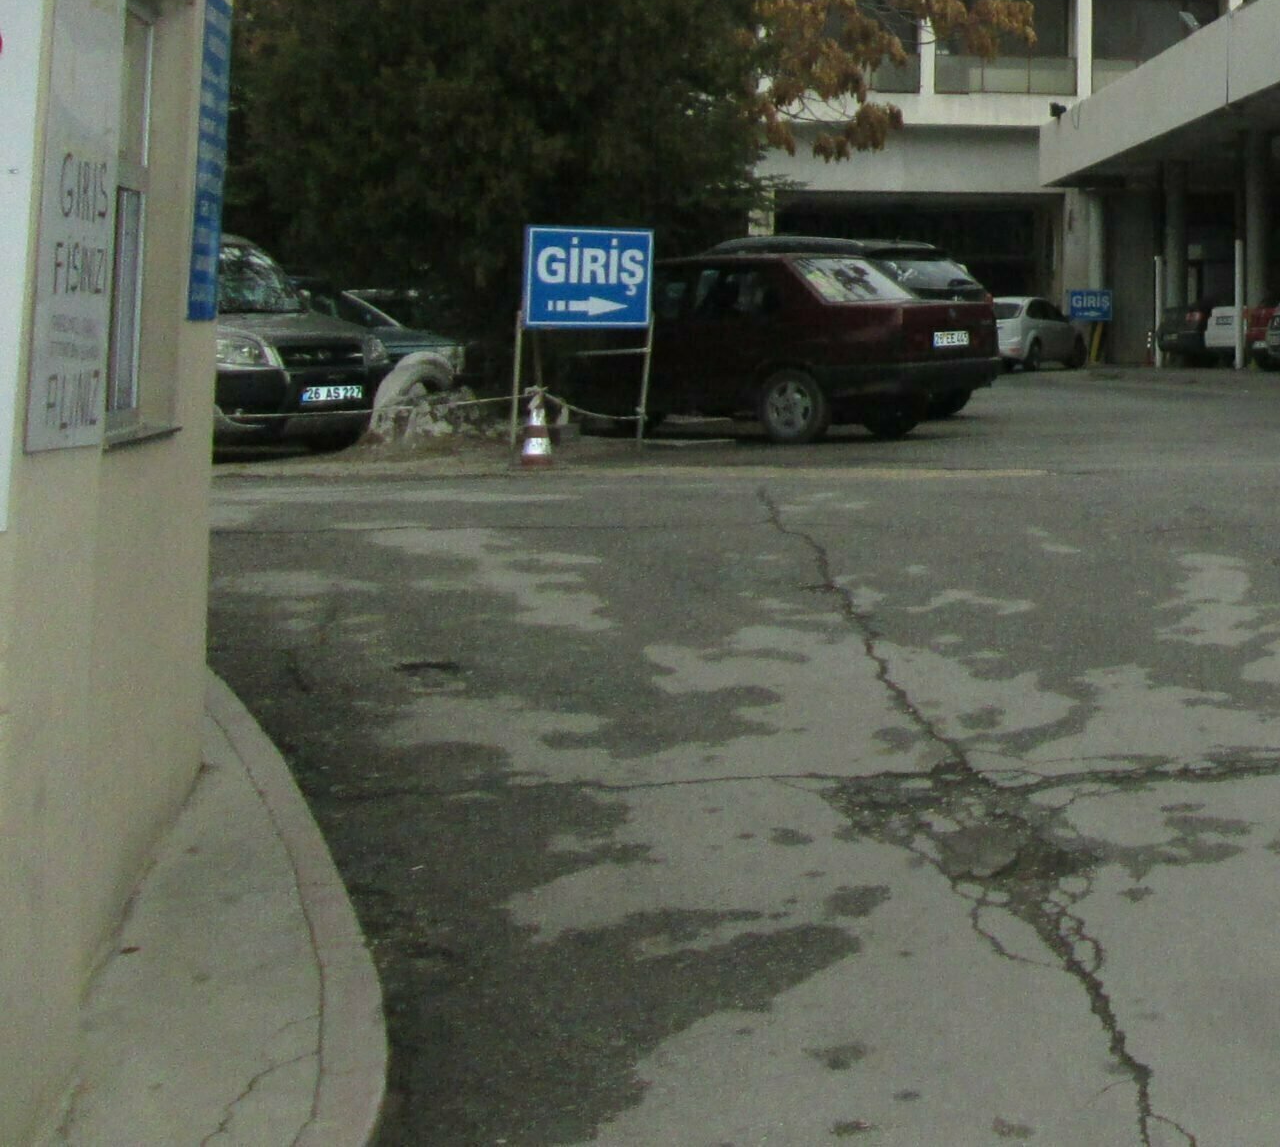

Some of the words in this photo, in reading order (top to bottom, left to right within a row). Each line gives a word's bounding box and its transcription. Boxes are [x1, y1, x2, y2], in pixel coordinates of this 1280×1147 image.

[537, 236, 645, 295] GİRİŞ
[308, 388, 321, 399] 26
[326, 388, 341, 398] AS
